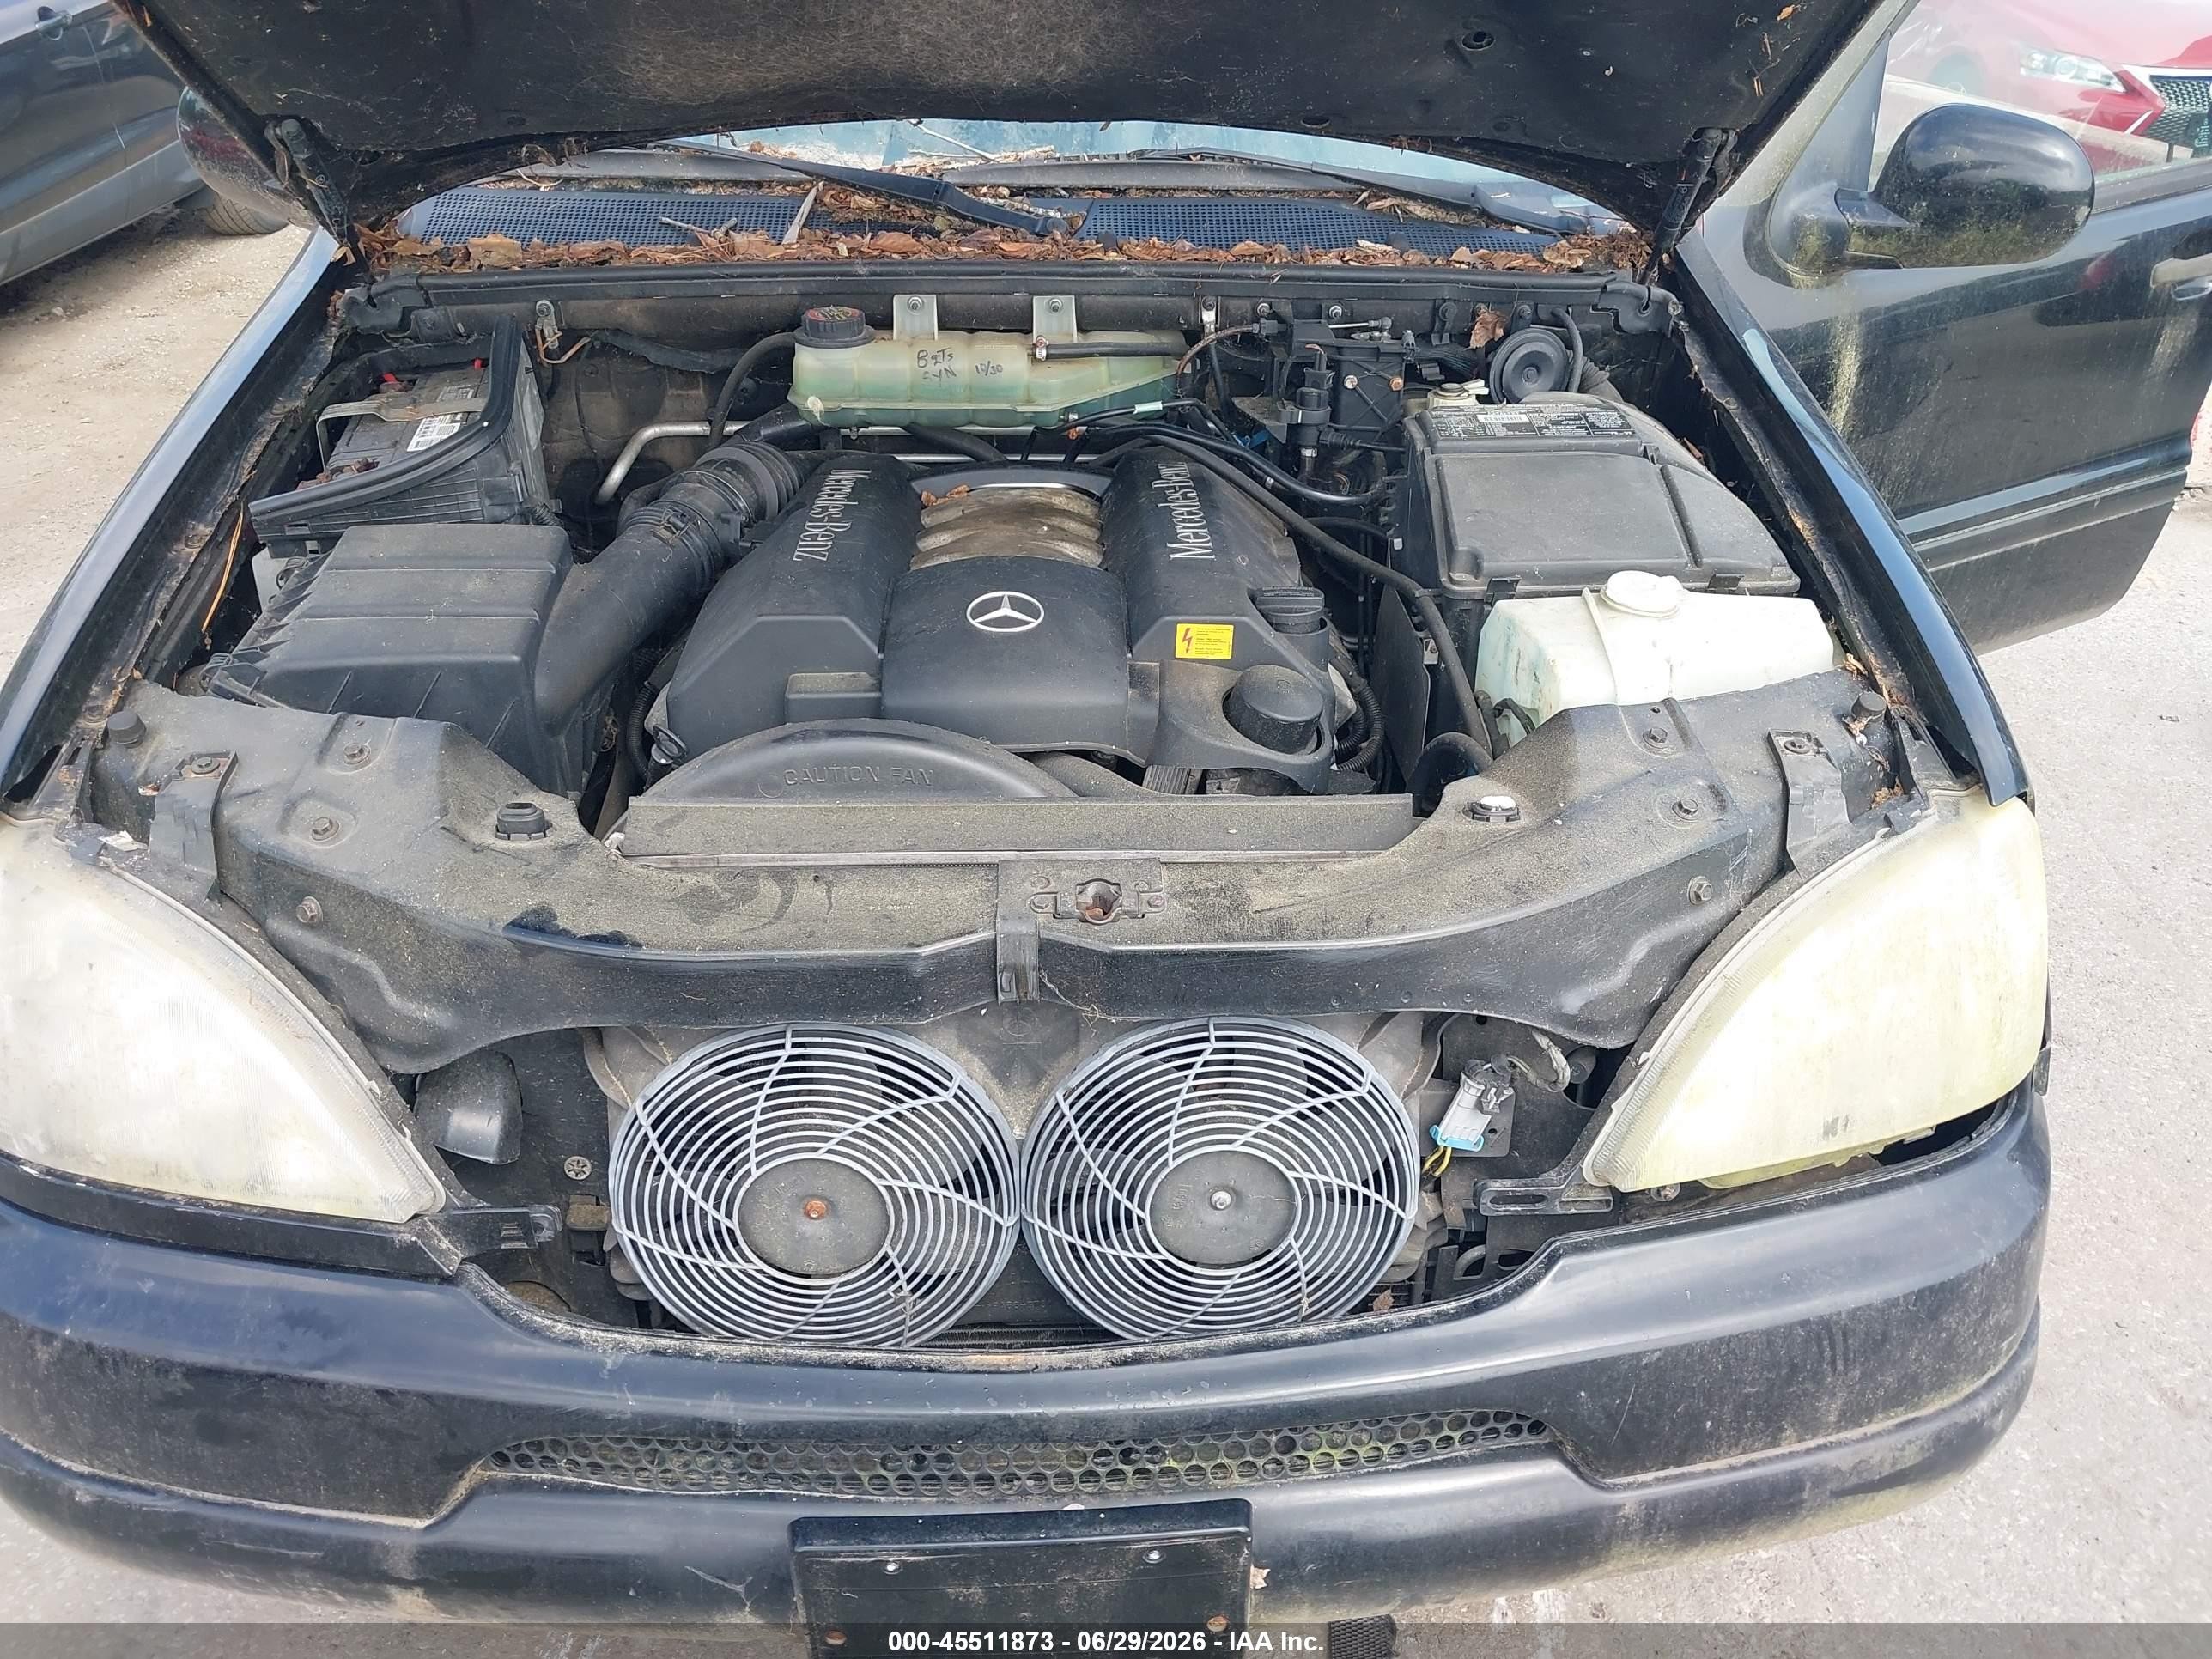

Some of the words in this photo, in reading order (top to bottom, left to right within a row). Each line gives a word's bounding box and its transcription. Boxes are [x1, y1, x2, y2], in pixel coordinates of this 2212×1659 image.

[793, 469, 872, 562] Mercedes-Benz
[1152, 462, 1216, 561] Mercedes-Benz
[783, 765, 880, 786] CAUTION
[890, 766, 934, 787] FAN
